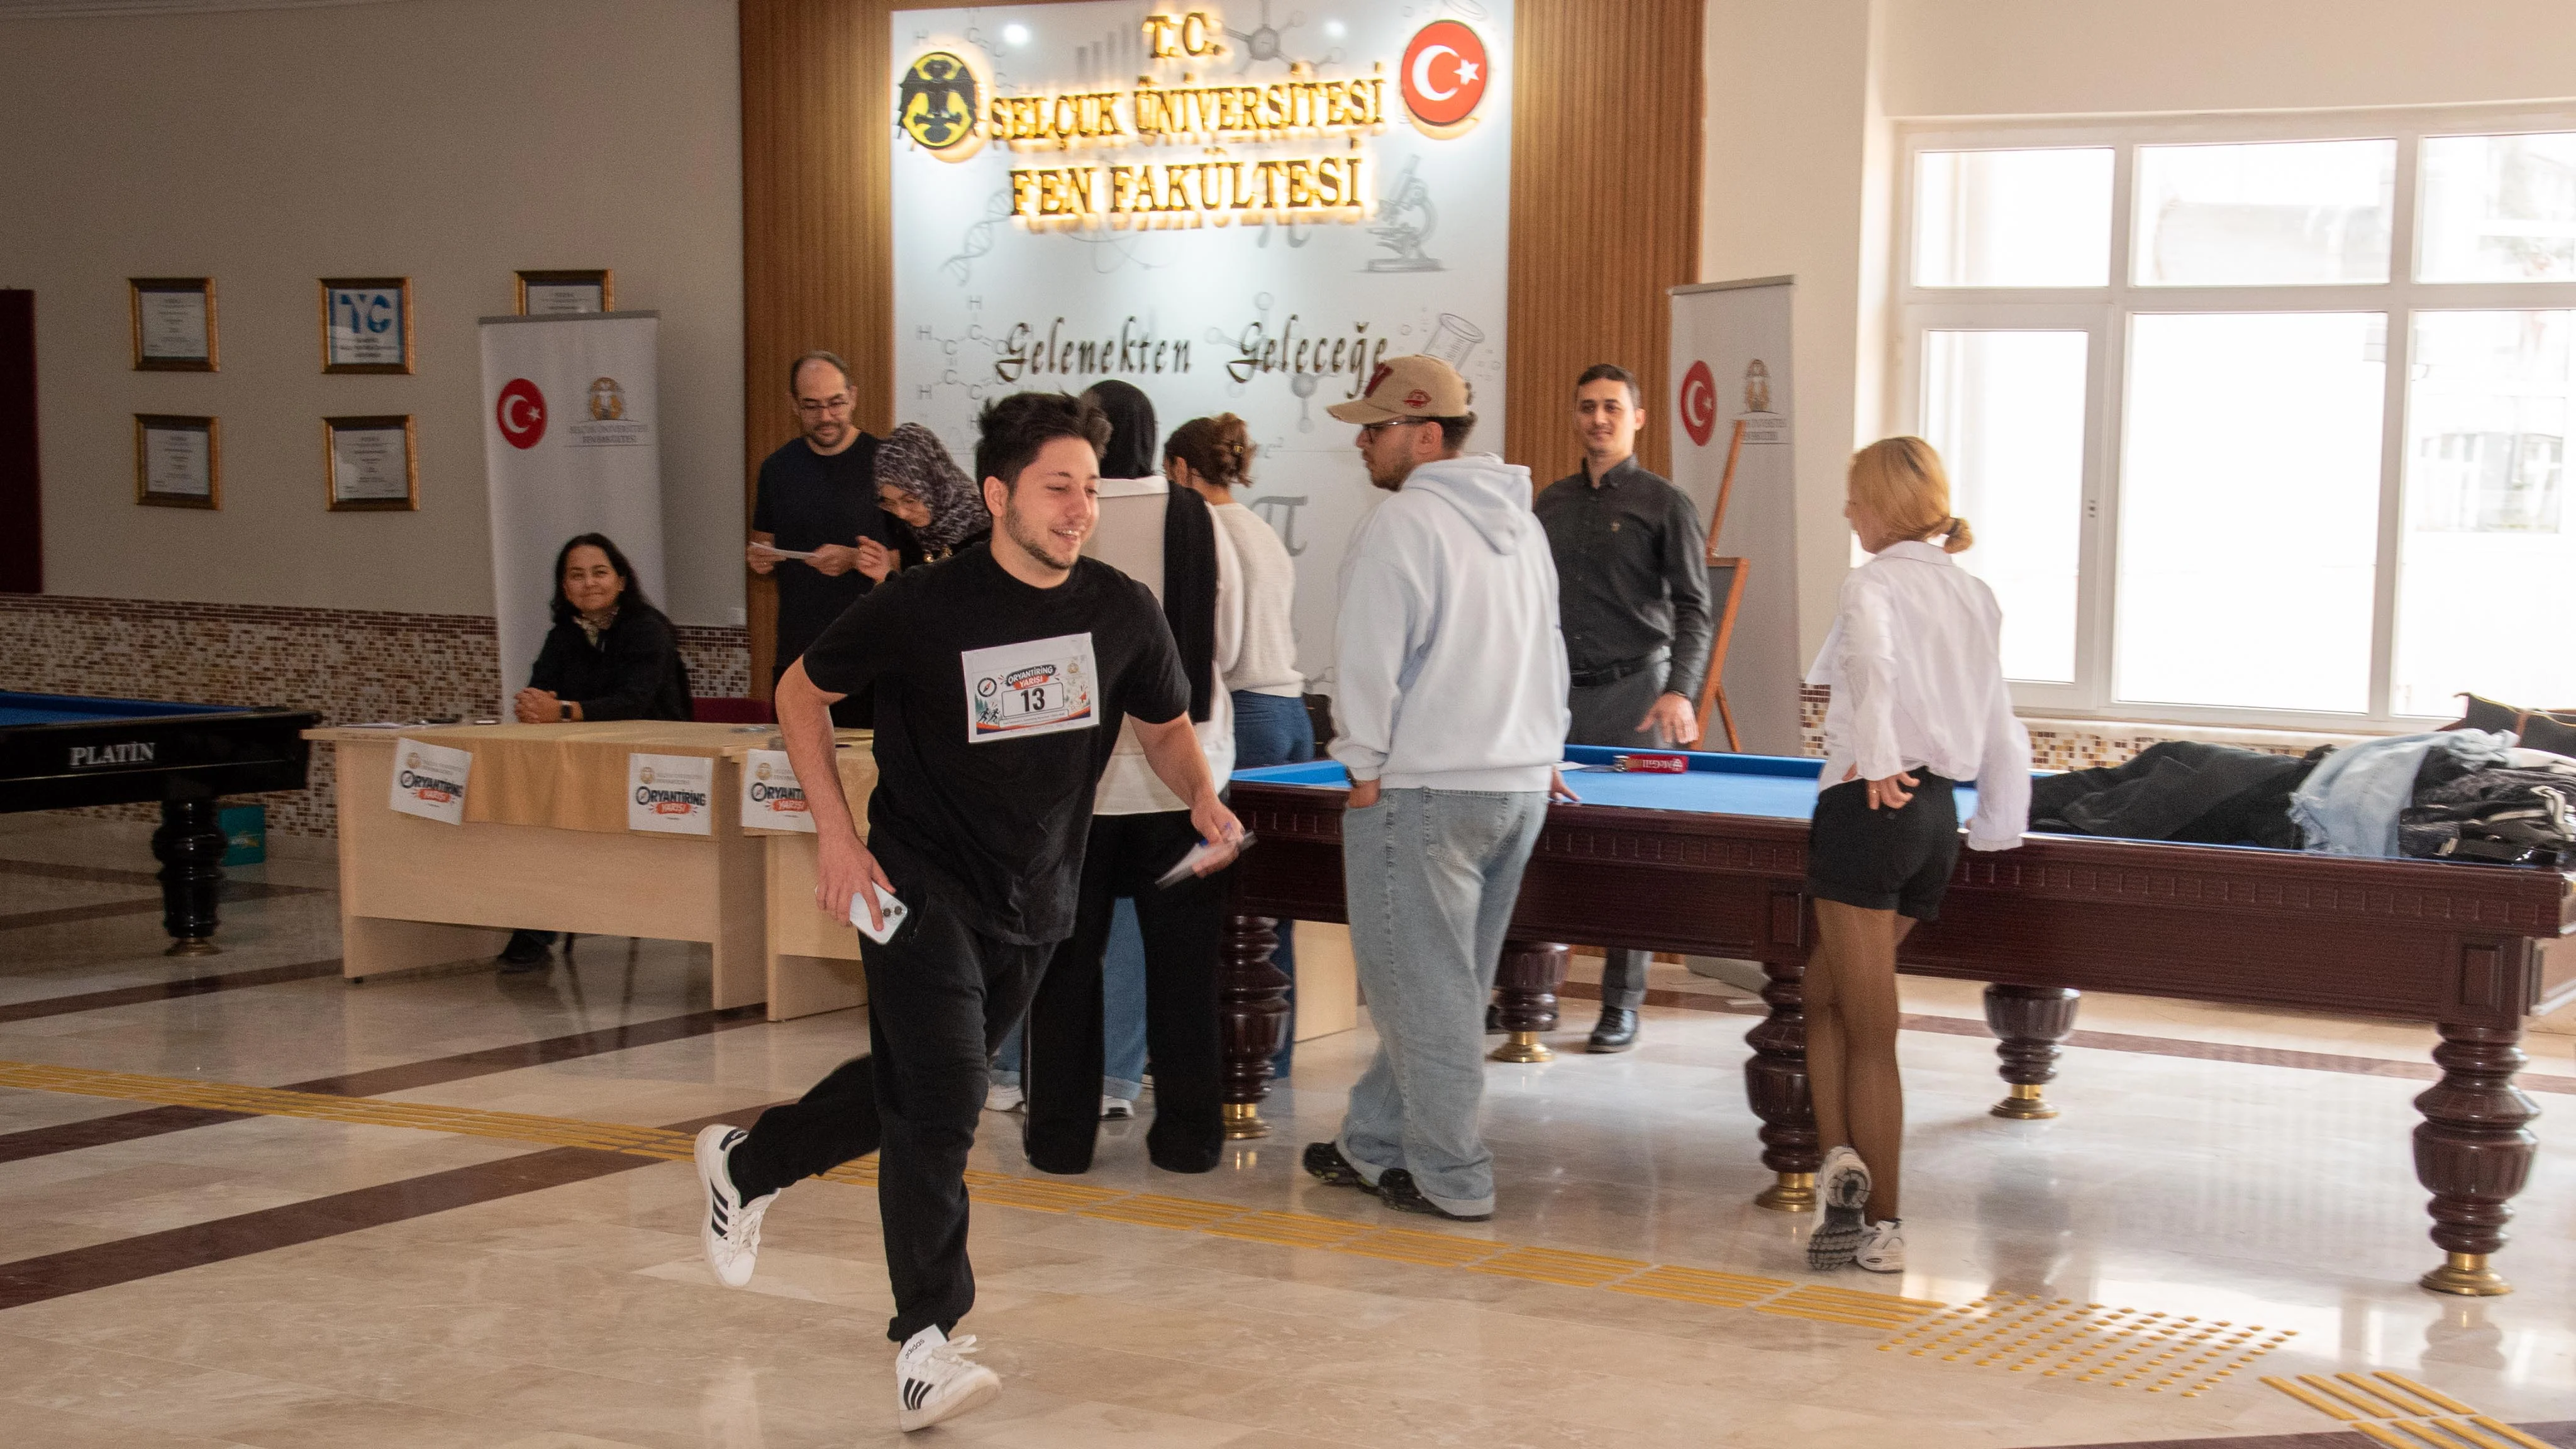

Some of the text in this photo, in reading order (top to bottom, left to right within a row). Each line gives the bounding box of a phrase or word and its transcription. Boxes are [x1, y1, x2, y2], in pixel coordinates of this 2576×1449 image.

[1144, 13, 1222, 59] T.C.
[991, 62, 1385, 148] SELÇUK ÜNİVERSİTESİ
[1009, 137, 1363, 216] FEN FAKÜLTESİ
[994, 313, 1389, 399] Gelenekten Geleceğe
[1020, 687, 1045, 712] 13
[1642, 759, 1673, 769] McGill
[906, 1339, 925, 1359] adidas
